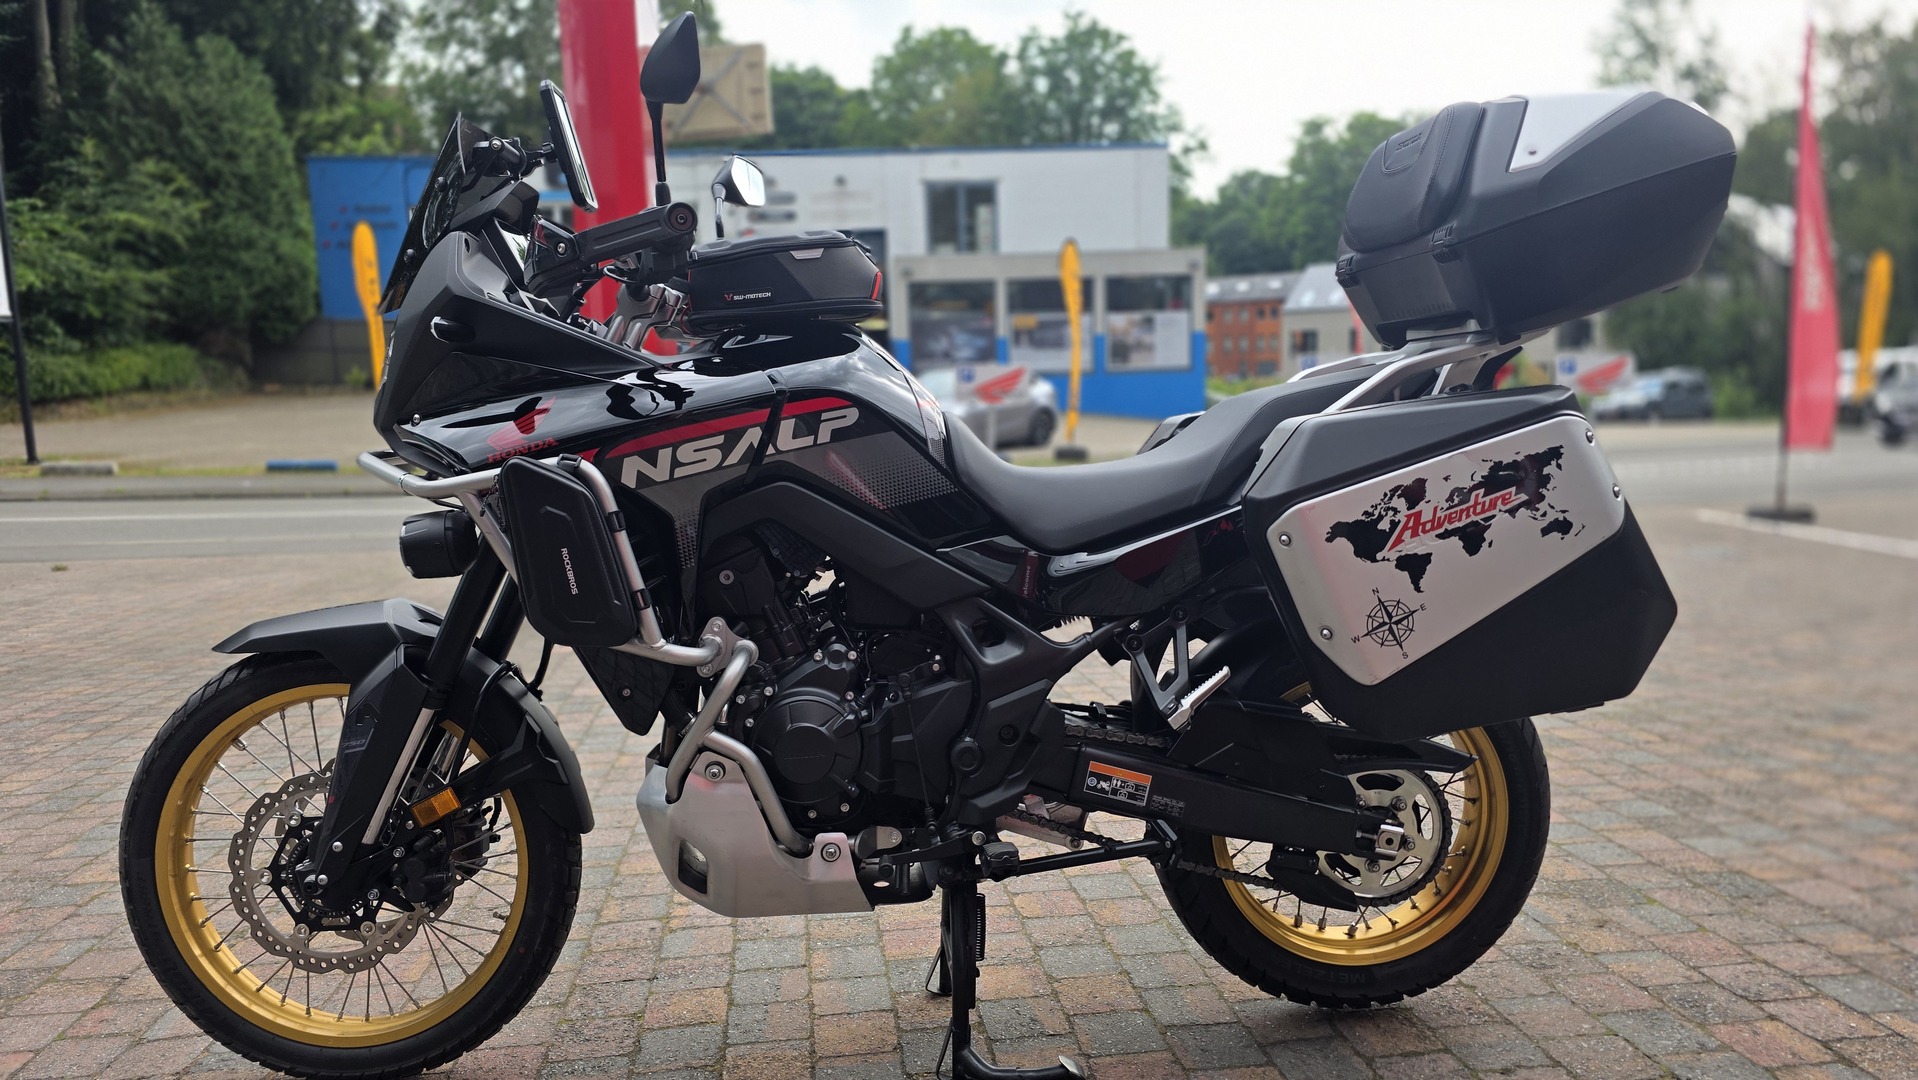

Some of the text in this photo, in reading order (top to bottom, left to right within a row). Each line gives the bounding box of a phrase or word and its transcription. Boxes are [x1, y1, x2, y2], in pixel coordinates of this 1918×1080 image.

[733, 292, 771, 301] SW-MOTECH
[487, 438, 558, 464] HONDA
[620, 406, 859, 489] NSALP
[1387, 489, 1523, 553] Adventure
[561, 547, 579, 595] ROCKBROS
[1371, 587, 1380, 596] N
[1419, 603, 1428, 612] E
[1350, 634, 1361, 644] W
[1401, 651, 1409, 660] S
